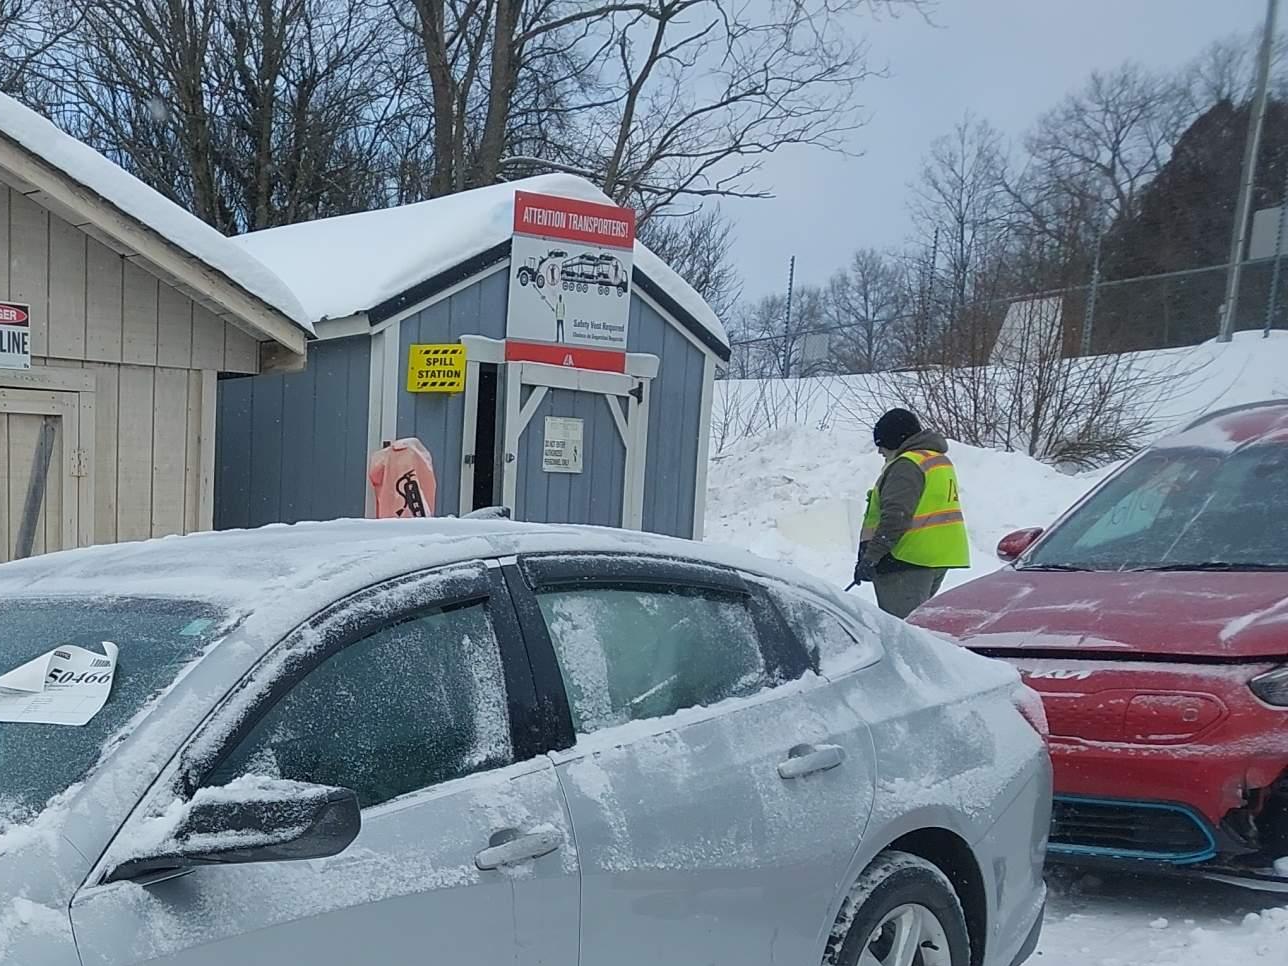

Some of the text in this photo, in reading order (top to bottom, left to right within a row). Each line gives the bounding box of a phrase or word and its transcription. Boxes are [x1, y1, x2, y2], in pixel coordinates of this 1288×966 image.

[523, 207, 629, 239] ATTENTION TRANSPORTERS!
[426, 357, 455, 367] SPILL
[417, 370, 461, 379] STATION
[44, 668, 112, 684] 50466
